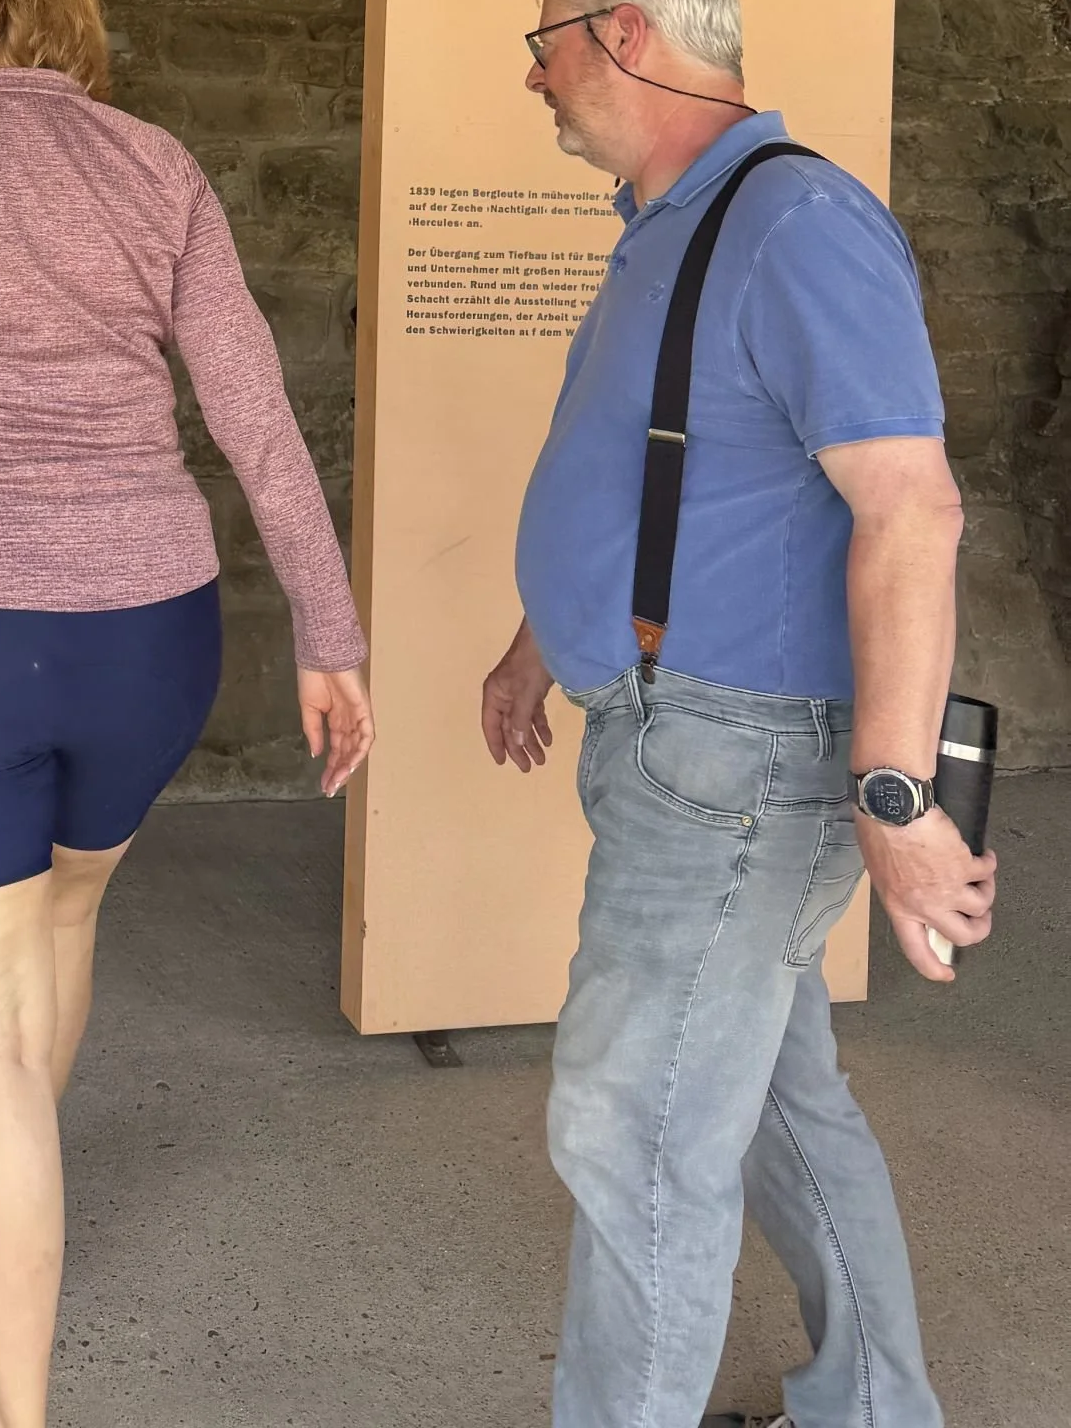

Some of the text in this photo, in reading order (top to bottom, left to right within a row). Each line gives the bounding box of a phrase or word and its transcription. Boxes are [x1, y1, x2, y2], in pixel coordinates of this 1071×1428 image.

[409, 187, 436, 196] 1839
[440, 188, 469, 199] legen
[472, 189, 525, 199] Bergleute
[529, 190, 538, 199] in
[541, 191, 600, 201] mühevoller
[409, 203, 427, 211] auf
[430, 203, 448, 212] der
[451, 204, 483, 213] Zeche
[551, 207, 570, 215] den
[466, 220, 483, 228] an.
[408, 248, 427, 257] Der
[430, 246, 480, 260] Übergang
[483, 251, 505, 259] zum
[509, 250, 547, 260] Tiefbau
[551, 252, 565, 261] ist
[569, 252, 583, 261] für
[408, 264, 427, 272] und
[430, 264, 499, 274] Unternehmer
[503, 266, 520, 275] mit
[524, 267, 560, 276] großen
[407, 280, 467, 289] verbunden.
[470, 280, 497, 289] Rund
[519, 282, 539, 290] den
[542, 282, 577, 291] wieder
[407, 294, 449, 304] Schacht
[453, 295, 490, 305] erzählt
[494, 296, 511, 305] die
[514, 297, 577, 308] Ausstellung
[406, 310, 512, 322] Herausforderungen,
[516, 312, 533, 321] der
[537, 313, 569, 321] Arbeit
[406, 325, 425, 334] den
[429, 326, 515, 337] Schwierigkeiten
[540, 328, 561, 337] dem
